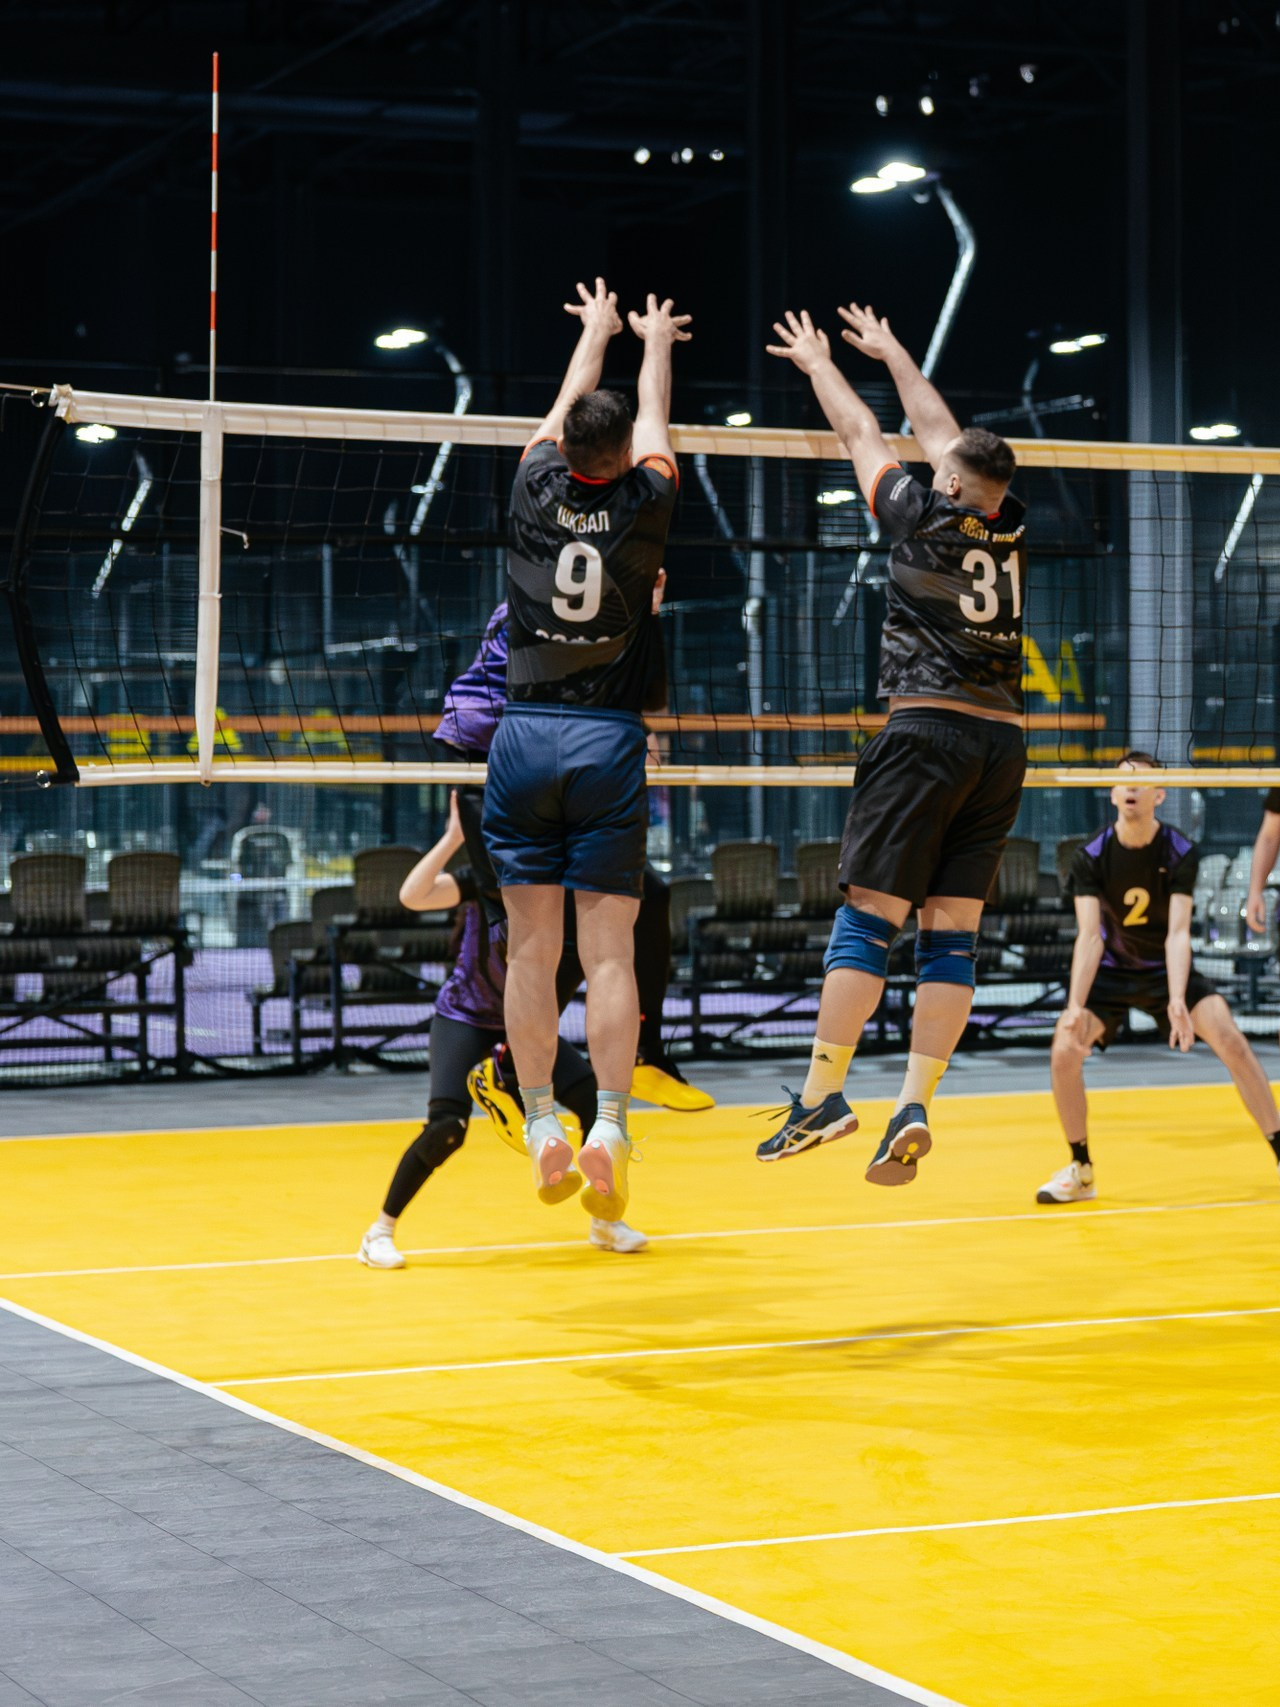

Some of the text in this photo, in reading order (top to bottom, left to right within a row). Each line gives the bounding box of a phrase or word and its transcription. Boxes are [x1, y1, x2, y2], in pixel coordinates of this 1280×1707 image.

[557, 505, 610, 534] ШКВАЛ
[552, 541, 602, 622] 9
[959, 549, 1021, 623] 31
[1123, 887, 1150, 927] 2
